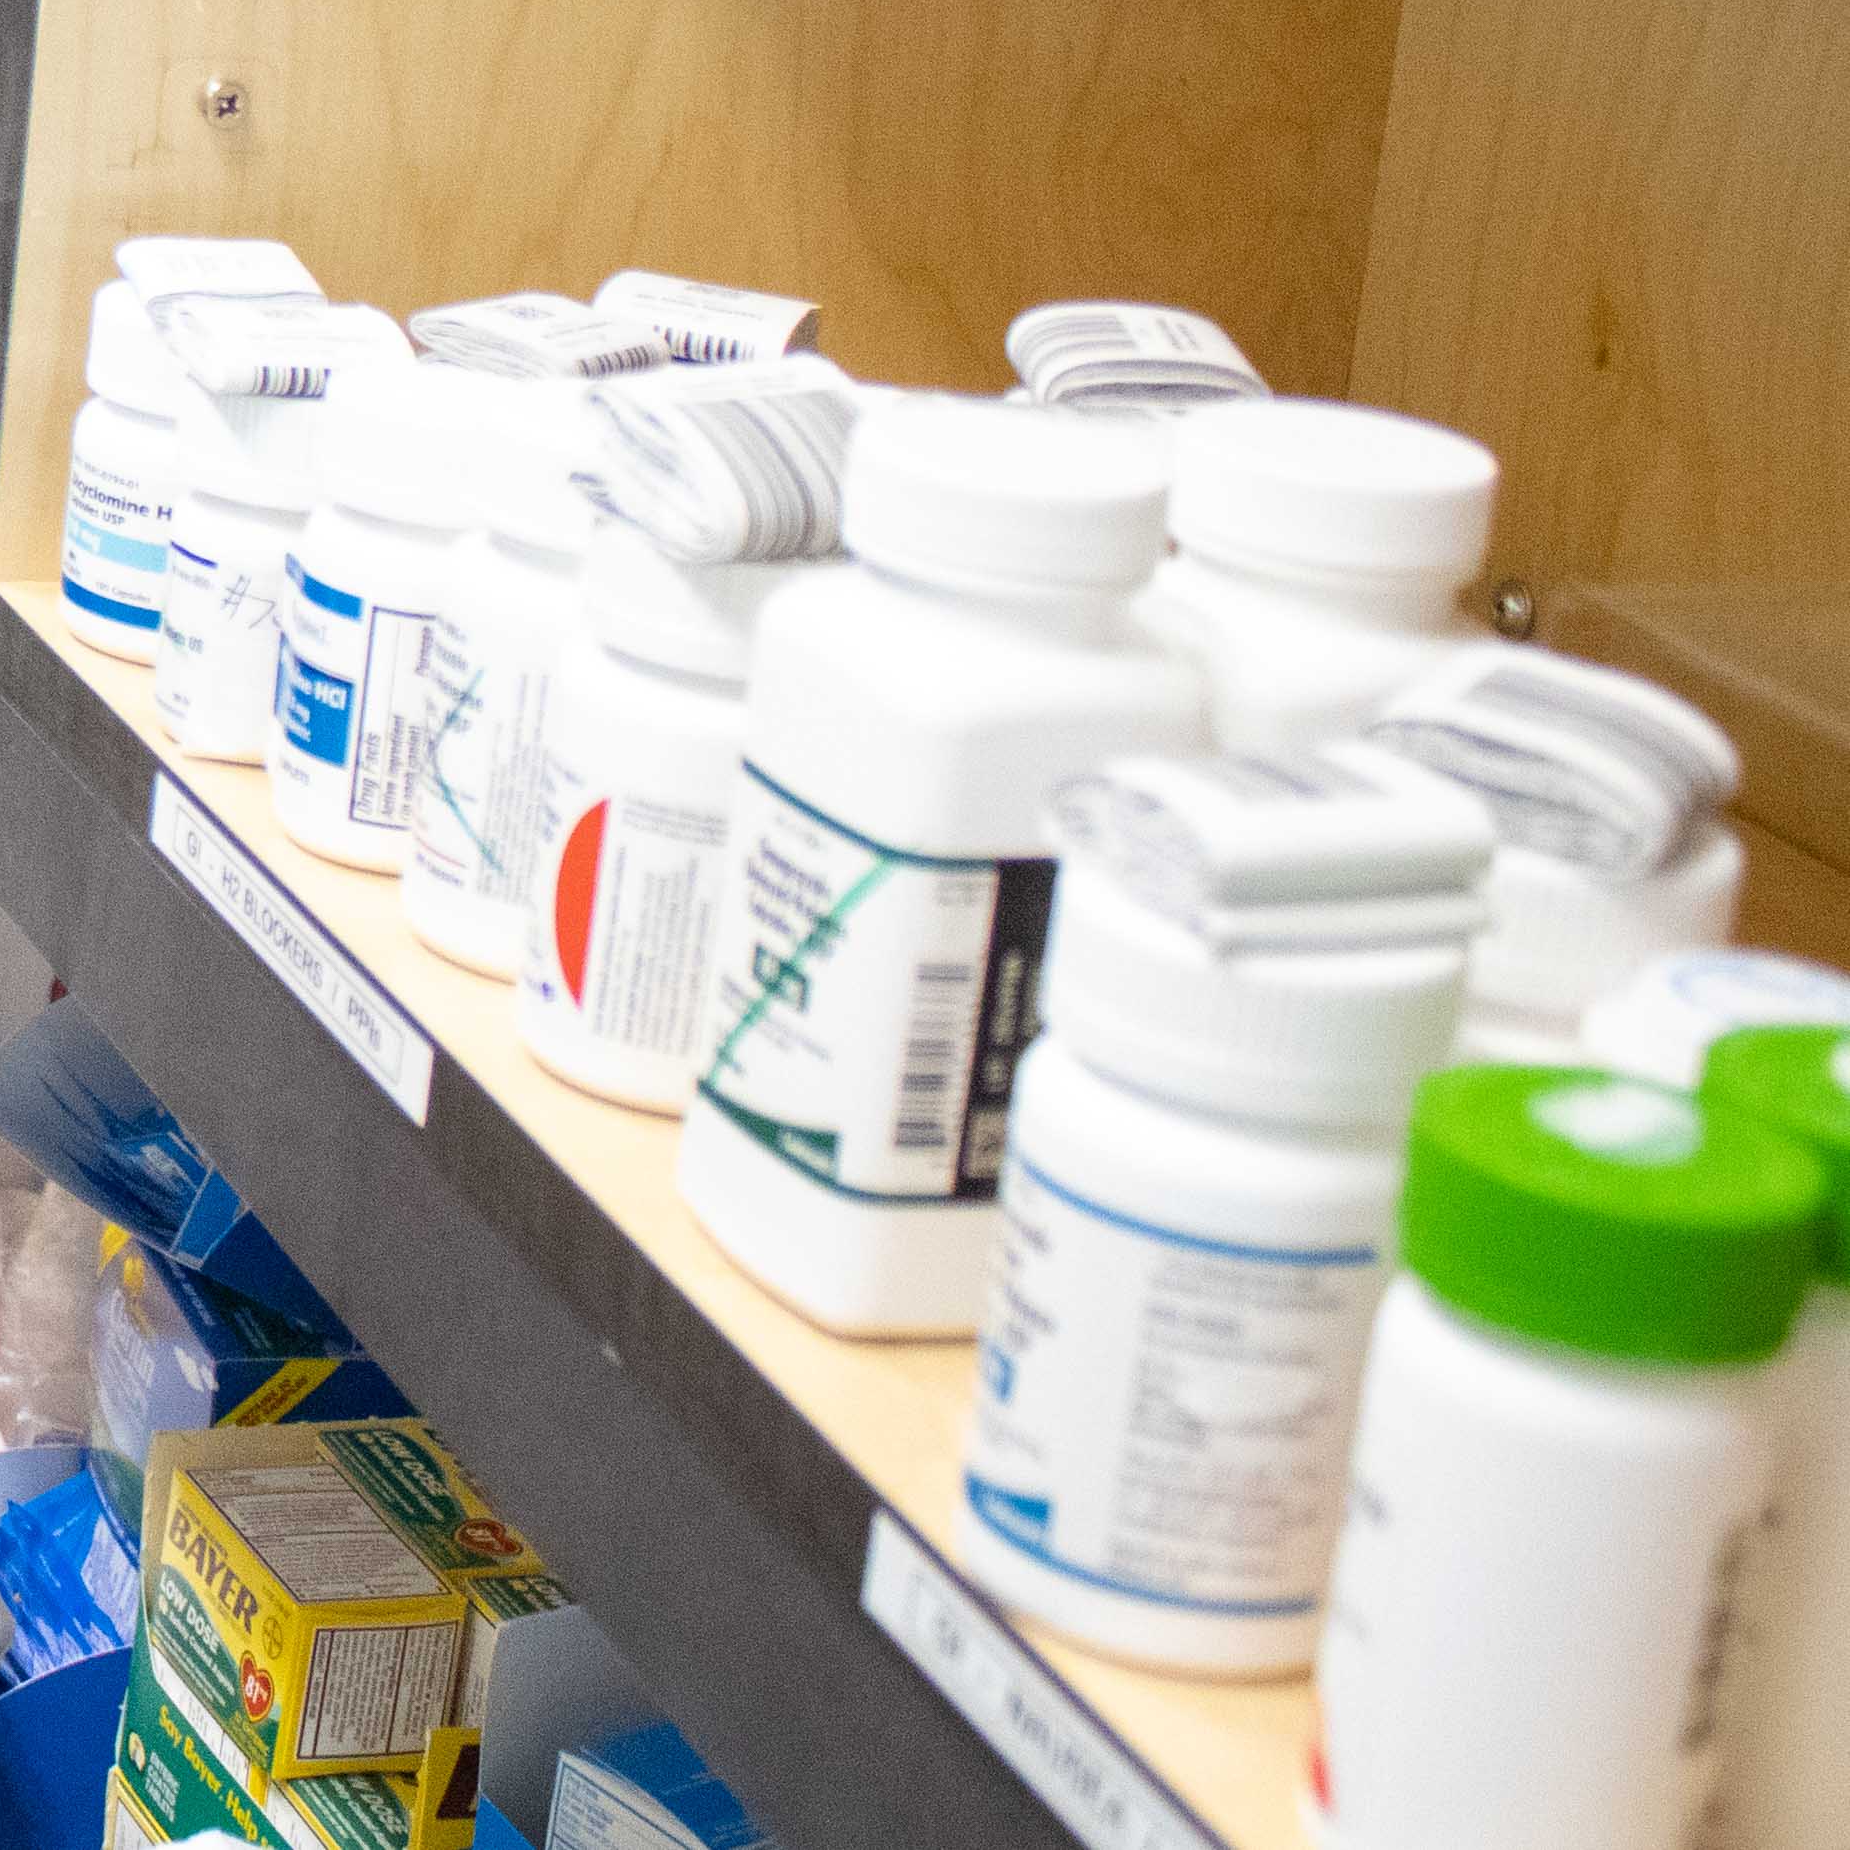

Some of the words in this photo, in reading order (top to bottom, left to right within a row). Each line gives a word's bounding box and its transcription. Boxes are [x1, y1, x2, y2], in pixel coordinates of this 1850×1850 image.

[243, 888, 325, 990] BLOCKERS
[158, 1571, 186, 1613] LOW
[186, 1606, 221, 1655] DOSE
[168, 1507, 259, 1635] BAYER
[244, 1674, 262, 1705] 81
[158, 1704, 183, 1749] Say
[225, 1791, 258, 1843] Help
